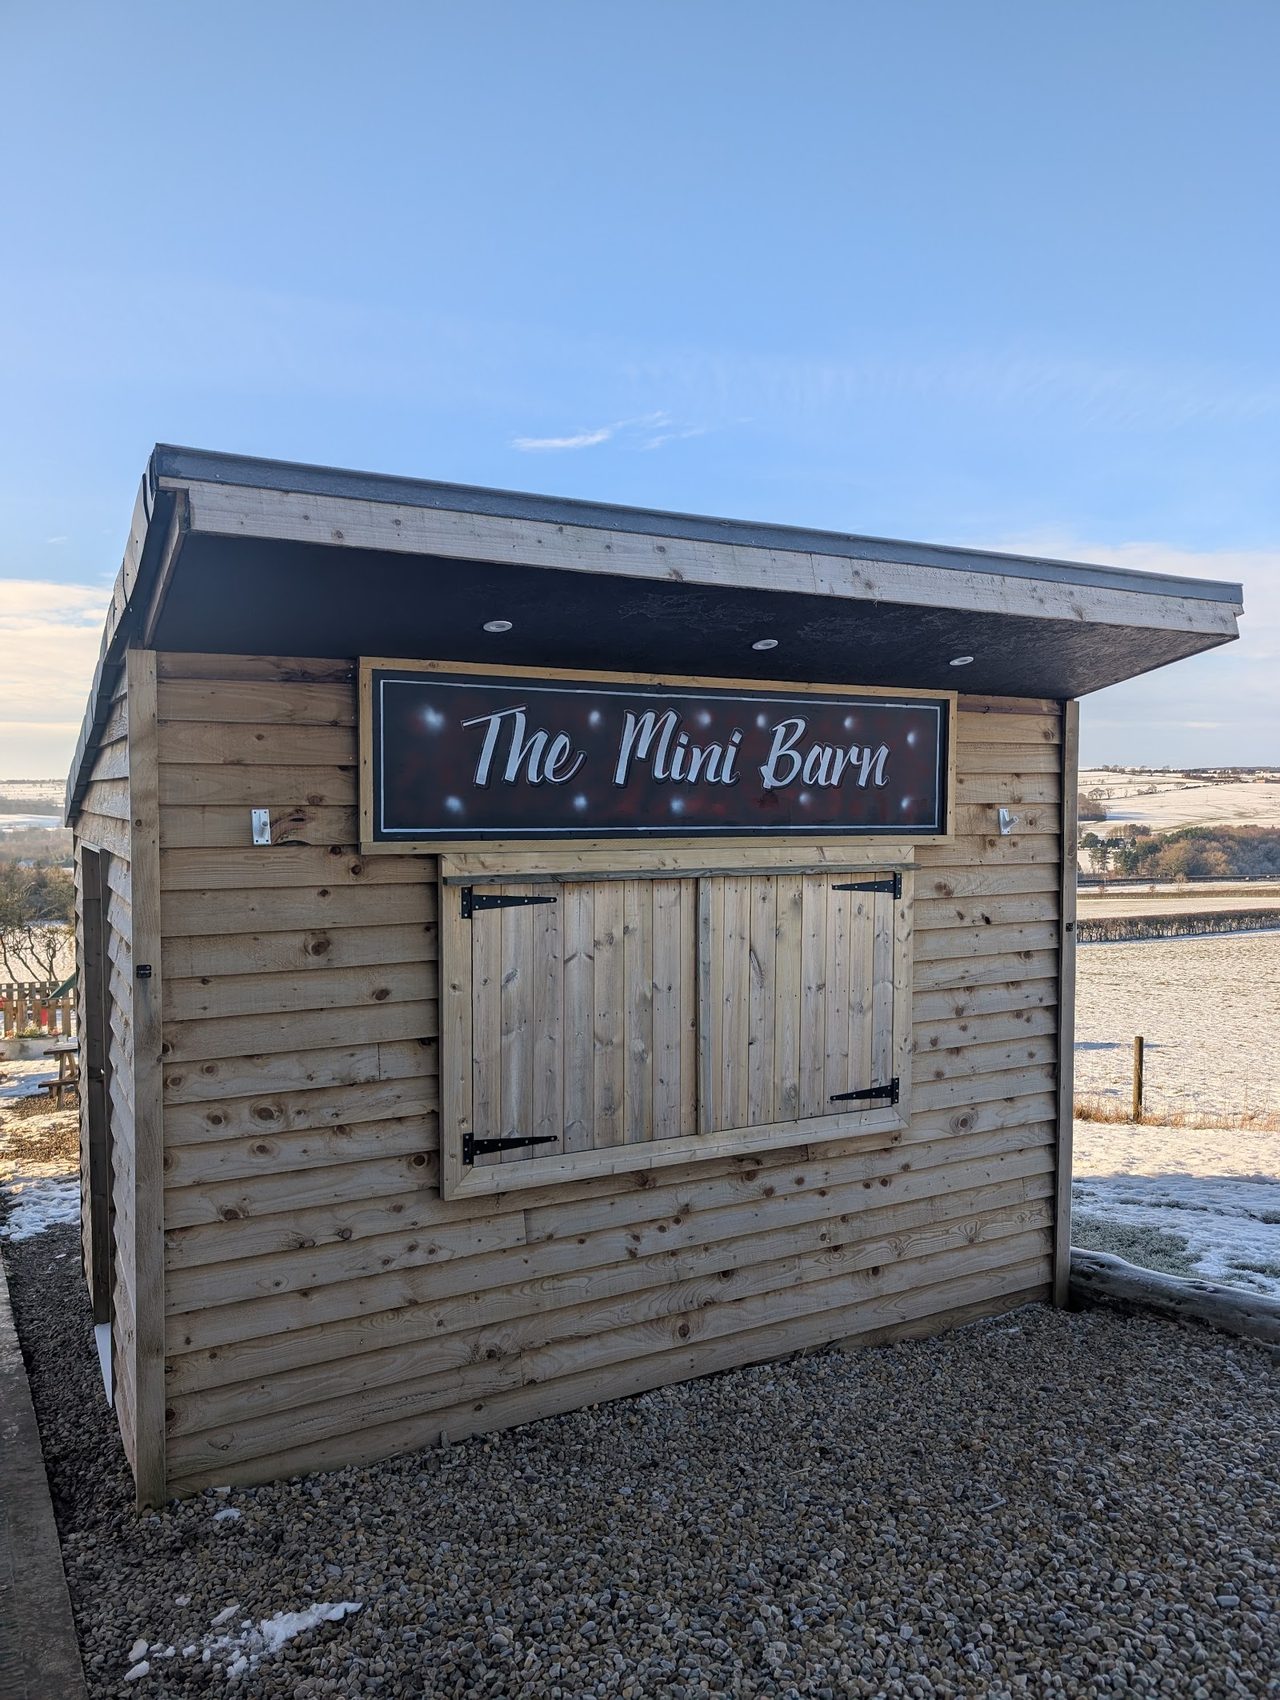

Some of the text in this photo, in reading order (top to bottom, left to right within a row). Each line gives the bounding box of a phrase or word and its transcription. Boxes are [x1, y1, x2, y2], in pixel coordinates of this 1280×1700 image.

[462, 705, 889, 790] The Mini Barn
